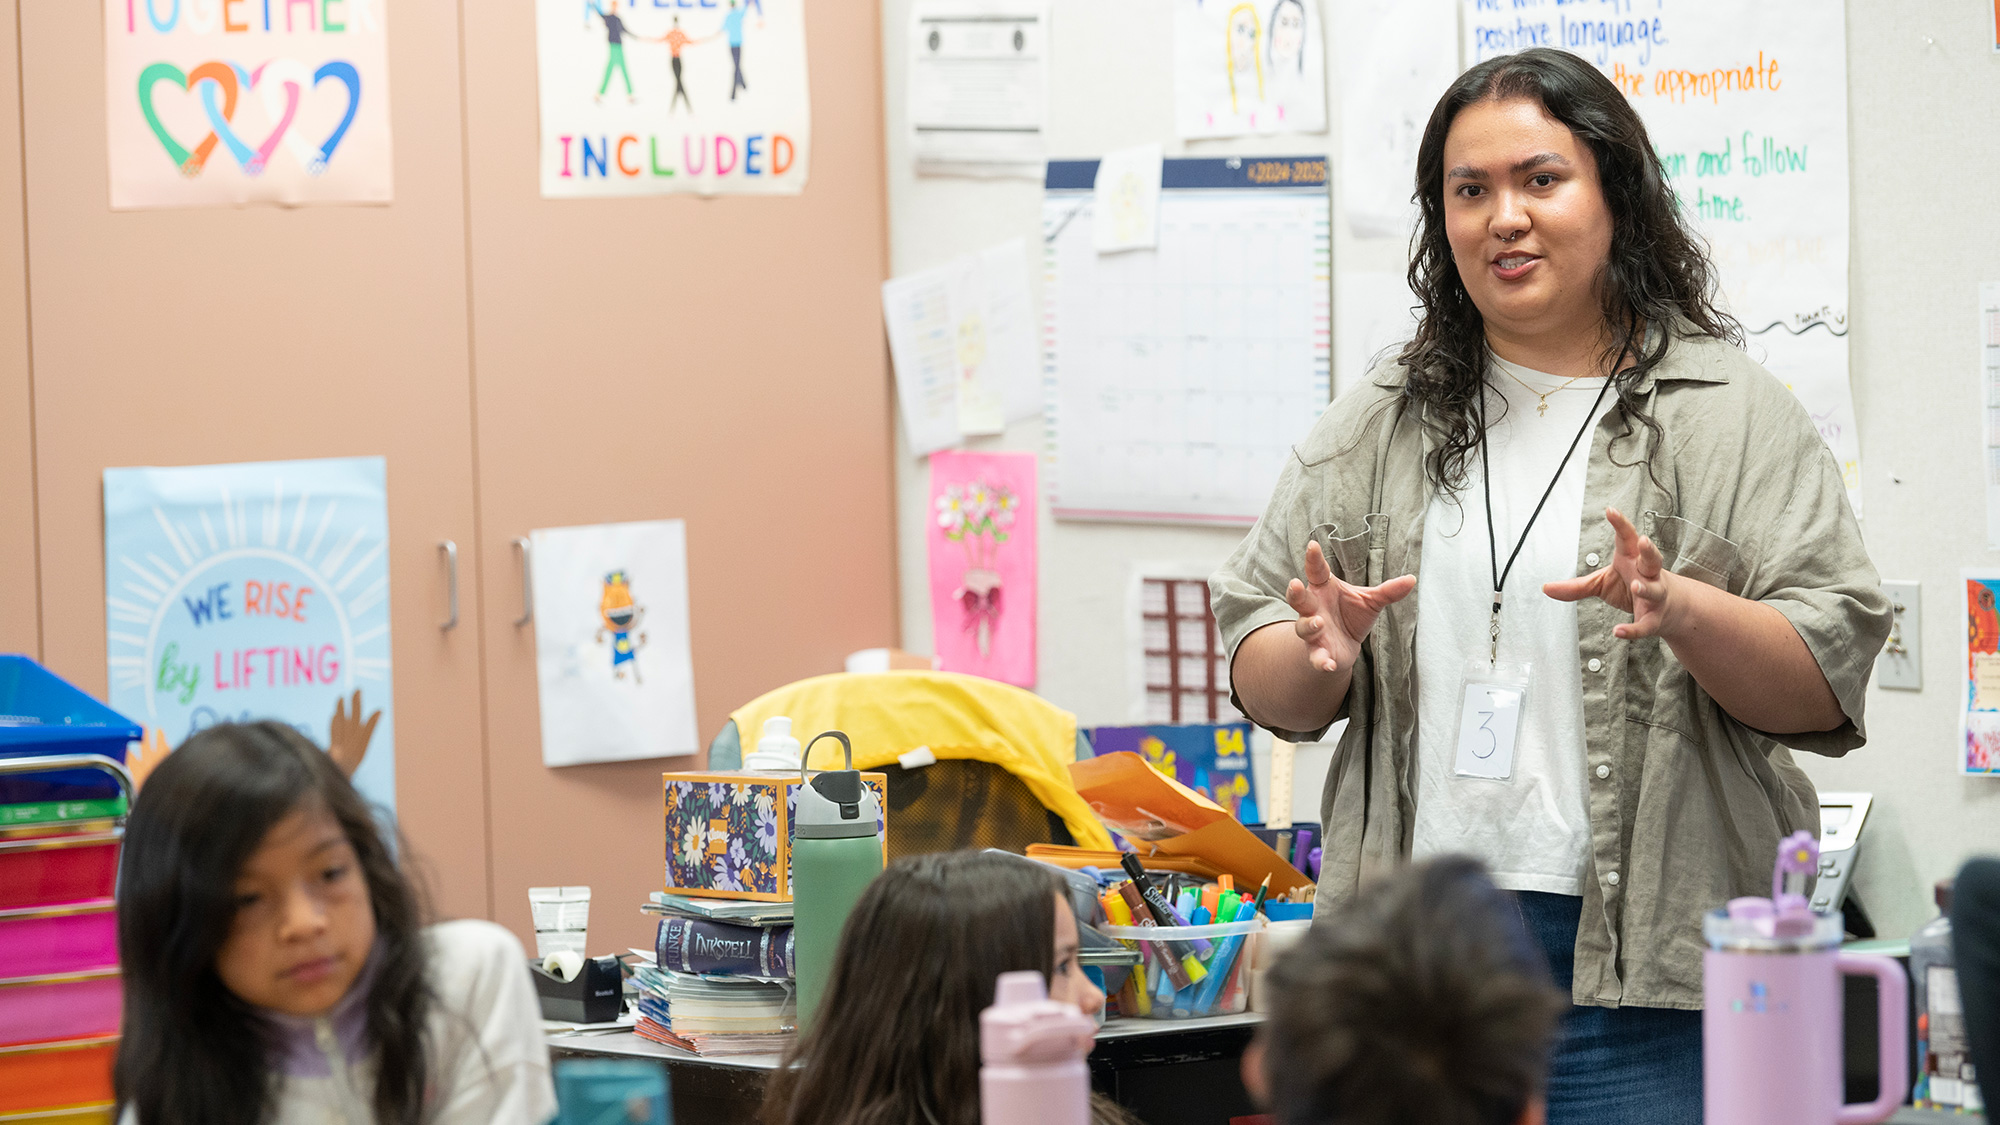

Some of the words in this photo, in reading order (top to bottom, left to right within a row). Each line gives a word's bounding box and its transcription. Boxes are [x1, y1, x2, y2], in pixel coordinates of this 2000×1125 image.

[1475, 16, 1551, 64] positive
[1613, 62, 1645, 97] the
[1654, 50, 1783, 105] appropriate
[558, 134, 796, 178] INCLUDED
[1697, 136, 1731, 178] and
[1742, 130, 1808, 177] follow
[183, 582, 233, 626] WE
[244, 580, 314, 623] RISE
[155, 641, 200, 705] by
[213, 643, 339, 691] LIFTING
[1471, 711, 1497, 759] 3
[668, 925, 682, 965] FUNKE
[695, 932, 755, 961] INKSPELL
